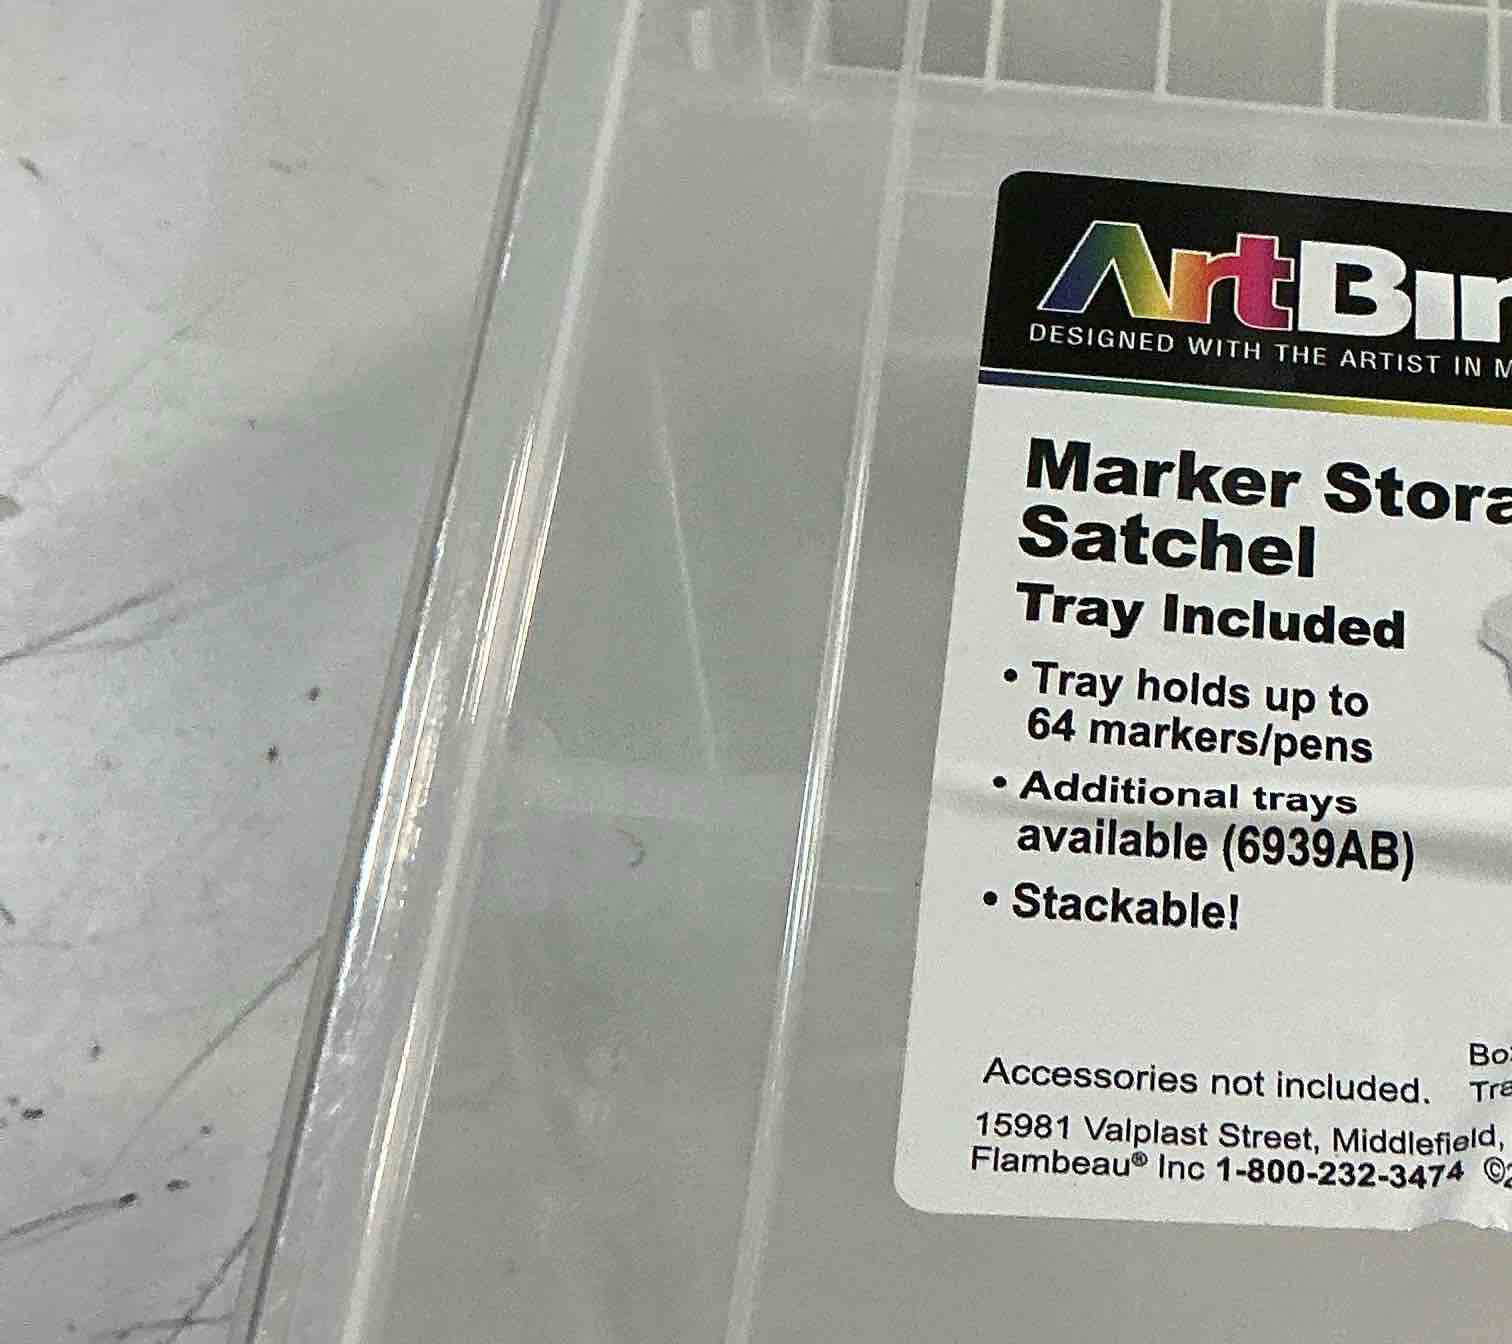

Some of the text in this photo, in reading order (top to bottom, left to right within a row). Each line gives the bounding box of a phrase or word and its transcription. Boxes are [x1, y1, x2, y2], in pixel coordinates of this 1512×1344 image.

[1029, 322, 1174, 353] DESIGNED
[1188, 335, 1261, 361] WITH
[1273, 343, 1327, 366] THE
[1340, 350, 1441, 375] ARTIST
[1454, 356, 1481, 377] IN
[1025, 437, 1302, 508] Marker
[1017, 504, 1315, 578] Satchel
[1016, 582, 1405, 649] Tray Included
[1032, 661, 1369, 719] Tray holds up to
[1026, 708, 1373, 766] 64 markers/pens
[1019, 770, 1357, 822] Additional trays
[1017, 818, 1415, 881] available (6939AB)
[1011, 881, 1240, 930] Stackable!
[982, 1056, 1431, 1105] Accessories not included.
[976, 1112, 1070, 1141] 15981
[1083, 1115, 1208, 1148] Valplast
[1218, 1122, 1320, 1155] Street,
[1332, 1123, 1504, 1158] Middlefield,
[1159, 1157, 1205, 1182] Inc
[1216, 1157, 1465, 1190] 1-800-232-3474
